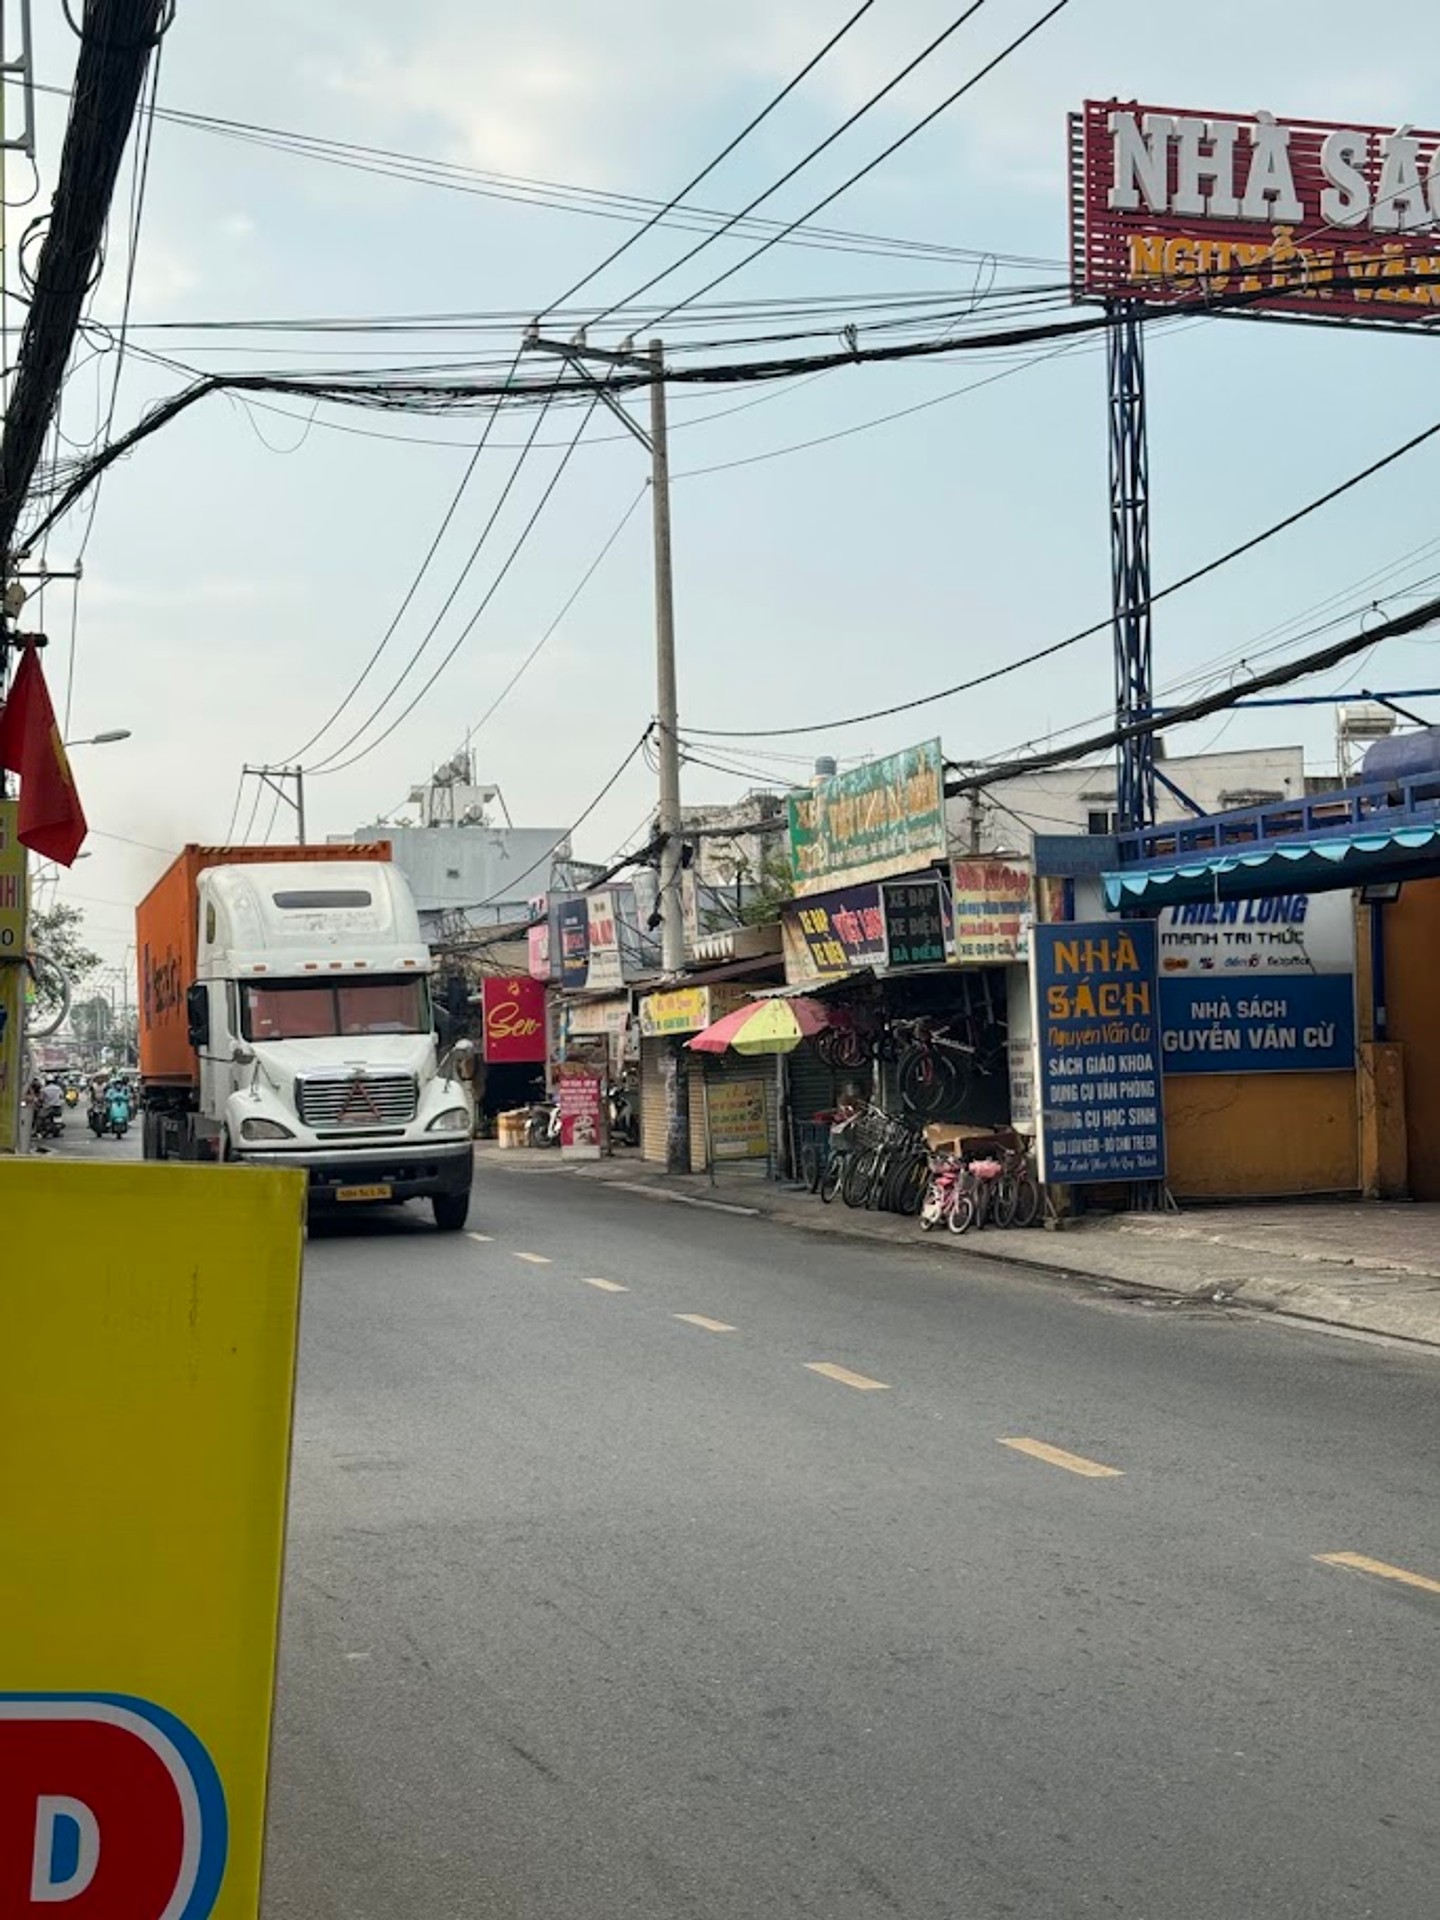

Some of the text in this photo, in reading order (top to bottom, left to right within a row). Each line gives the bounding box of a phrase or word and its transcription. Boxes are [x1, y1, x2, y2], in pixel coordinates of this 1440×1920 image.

[1319, 124, 1440, 232] SÁ
[1054, 930, 1140, 975] NHÀ
[1222, 932, 1252, 945] TRI
[1047, 977, 1151, 1020] SÁCH
[1191, 993, 1287, 1020] NHÀ SÁCH
[487, 1001, 542, 1038] Sen
[1162, 1020, 1336, 1052] GUYỄN VĂN CỪ
[1049, 1054, 1083, 1076] SÁCH
[1086, 1052, 1115, 1075] GIÁO
[1119, 1052, 1154, 1073] KHOA
[1084, 1109, 1100, 1132] CỤ
[29, 1794, 101, 1903] D
